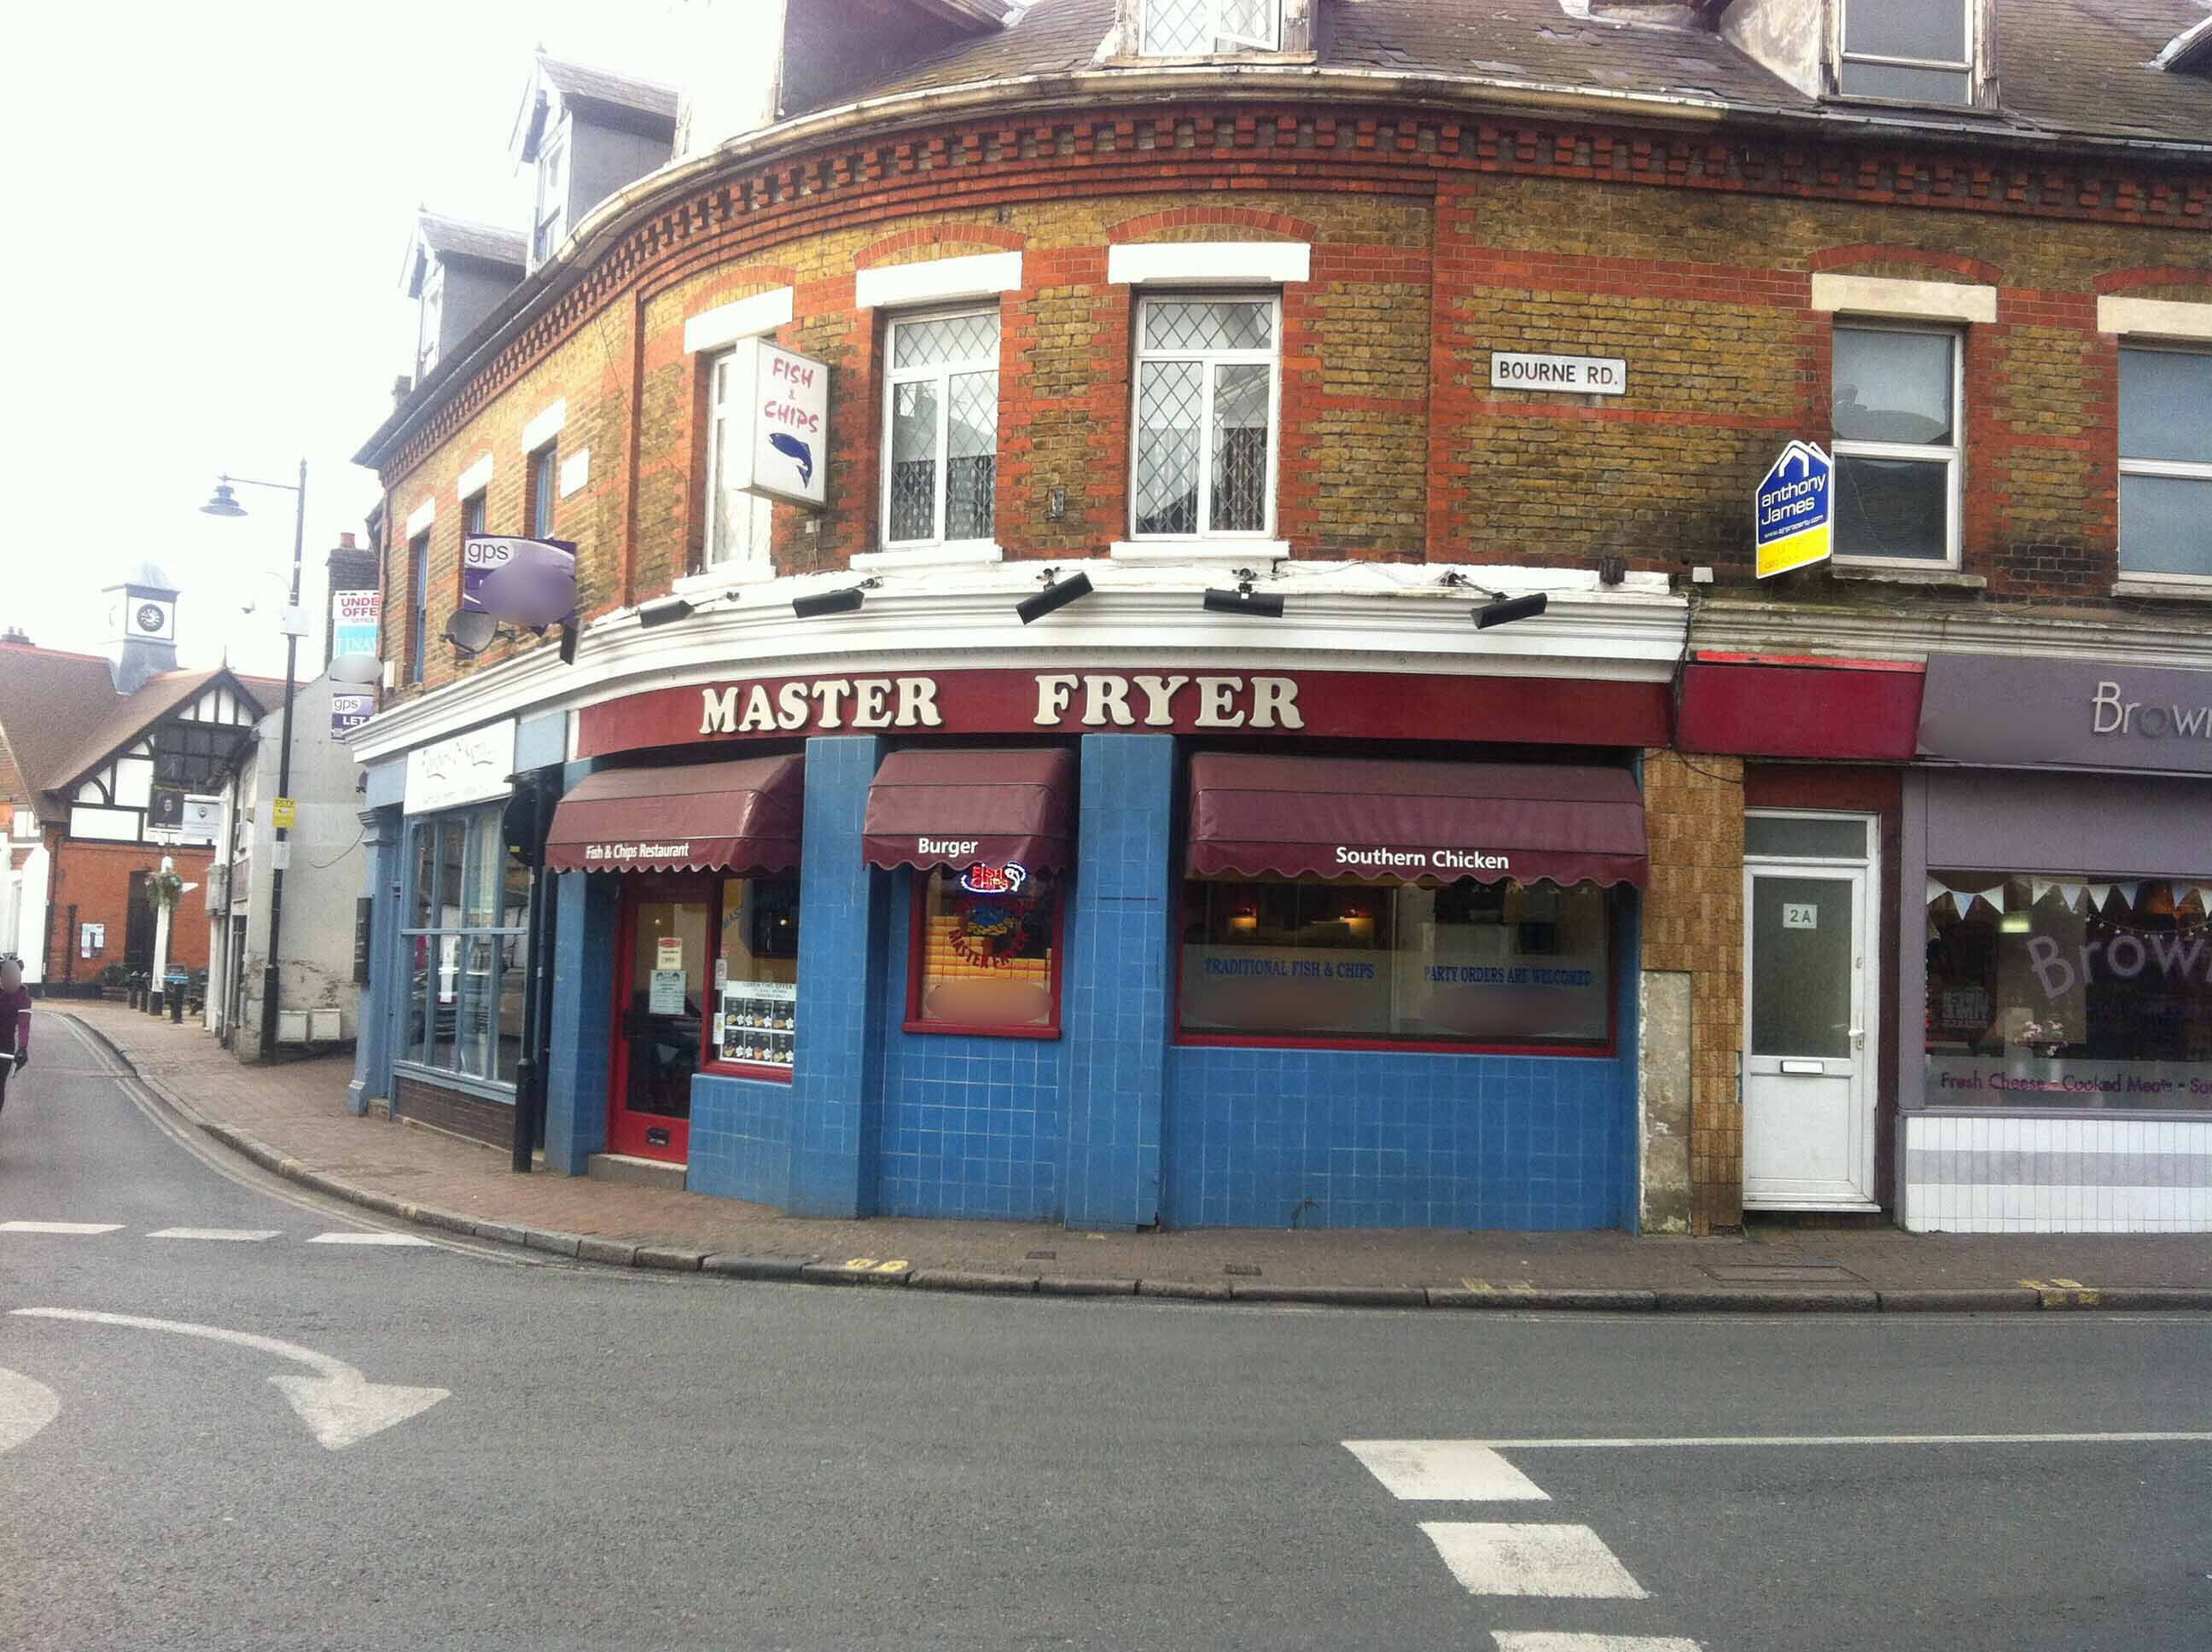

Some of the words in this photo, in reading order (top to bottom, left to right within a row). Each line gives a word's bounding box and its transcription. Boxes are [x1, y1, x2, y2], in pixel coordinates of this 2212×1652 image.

[772, 358, 814, 388] FISH
[1499, 361, 1576, 382] BOURNE
[1587, 366, 1618, 385] RD.
[788, 389, 796, 400] &
[764, 400, 819, 433] CHIPS
[1761, 474, 1826, 507] anthony
[1761, 497, 1815, 526] James
[468, 543, 509, 563] gps
[341, 597, 380, 607] UNDE
[342, 607, 379, 617] OFFE
[334, 698, 359, 712] gps
[699, 676, 943, 735] MASTER
[1033, 673, 1306, 730] FRYER
[2091, 681, 2212, 738] Brow
[342, 716, 366, 725] LET
[585, 845, 602, 859] Fish
[603, 845, 613, 858] &
[614, 843, 637, 861] Chips
[638, 841, 690, 858] Restaurant
[917, 838, 979, 858] Burger
[1336, 846, 1426, 866] Southern
[1432, 850, 1510, 869] Chicken
[1204, 957, 1288, 976] TRADITIONAL
[1291, 960, 1320, 977] FISH
[1324, 962, 1334, 977] &
[1336, 963, 1376, 980] CHIPS
[1423, 965, 1459, 981] PARTY
[1460, 967, 1505, 983] ORDERS
[1508, 969, 1529, 984] ARE
[2027, 935, 2212, 1002] Brow
[1941, 1071, 1982, 1090] Fresh
[1989, 1072, 2046, 1091] Cheese
[2061, 1073, 2122, 1093] Cooked
[2126, 1075, 2173, 1093] Meats
